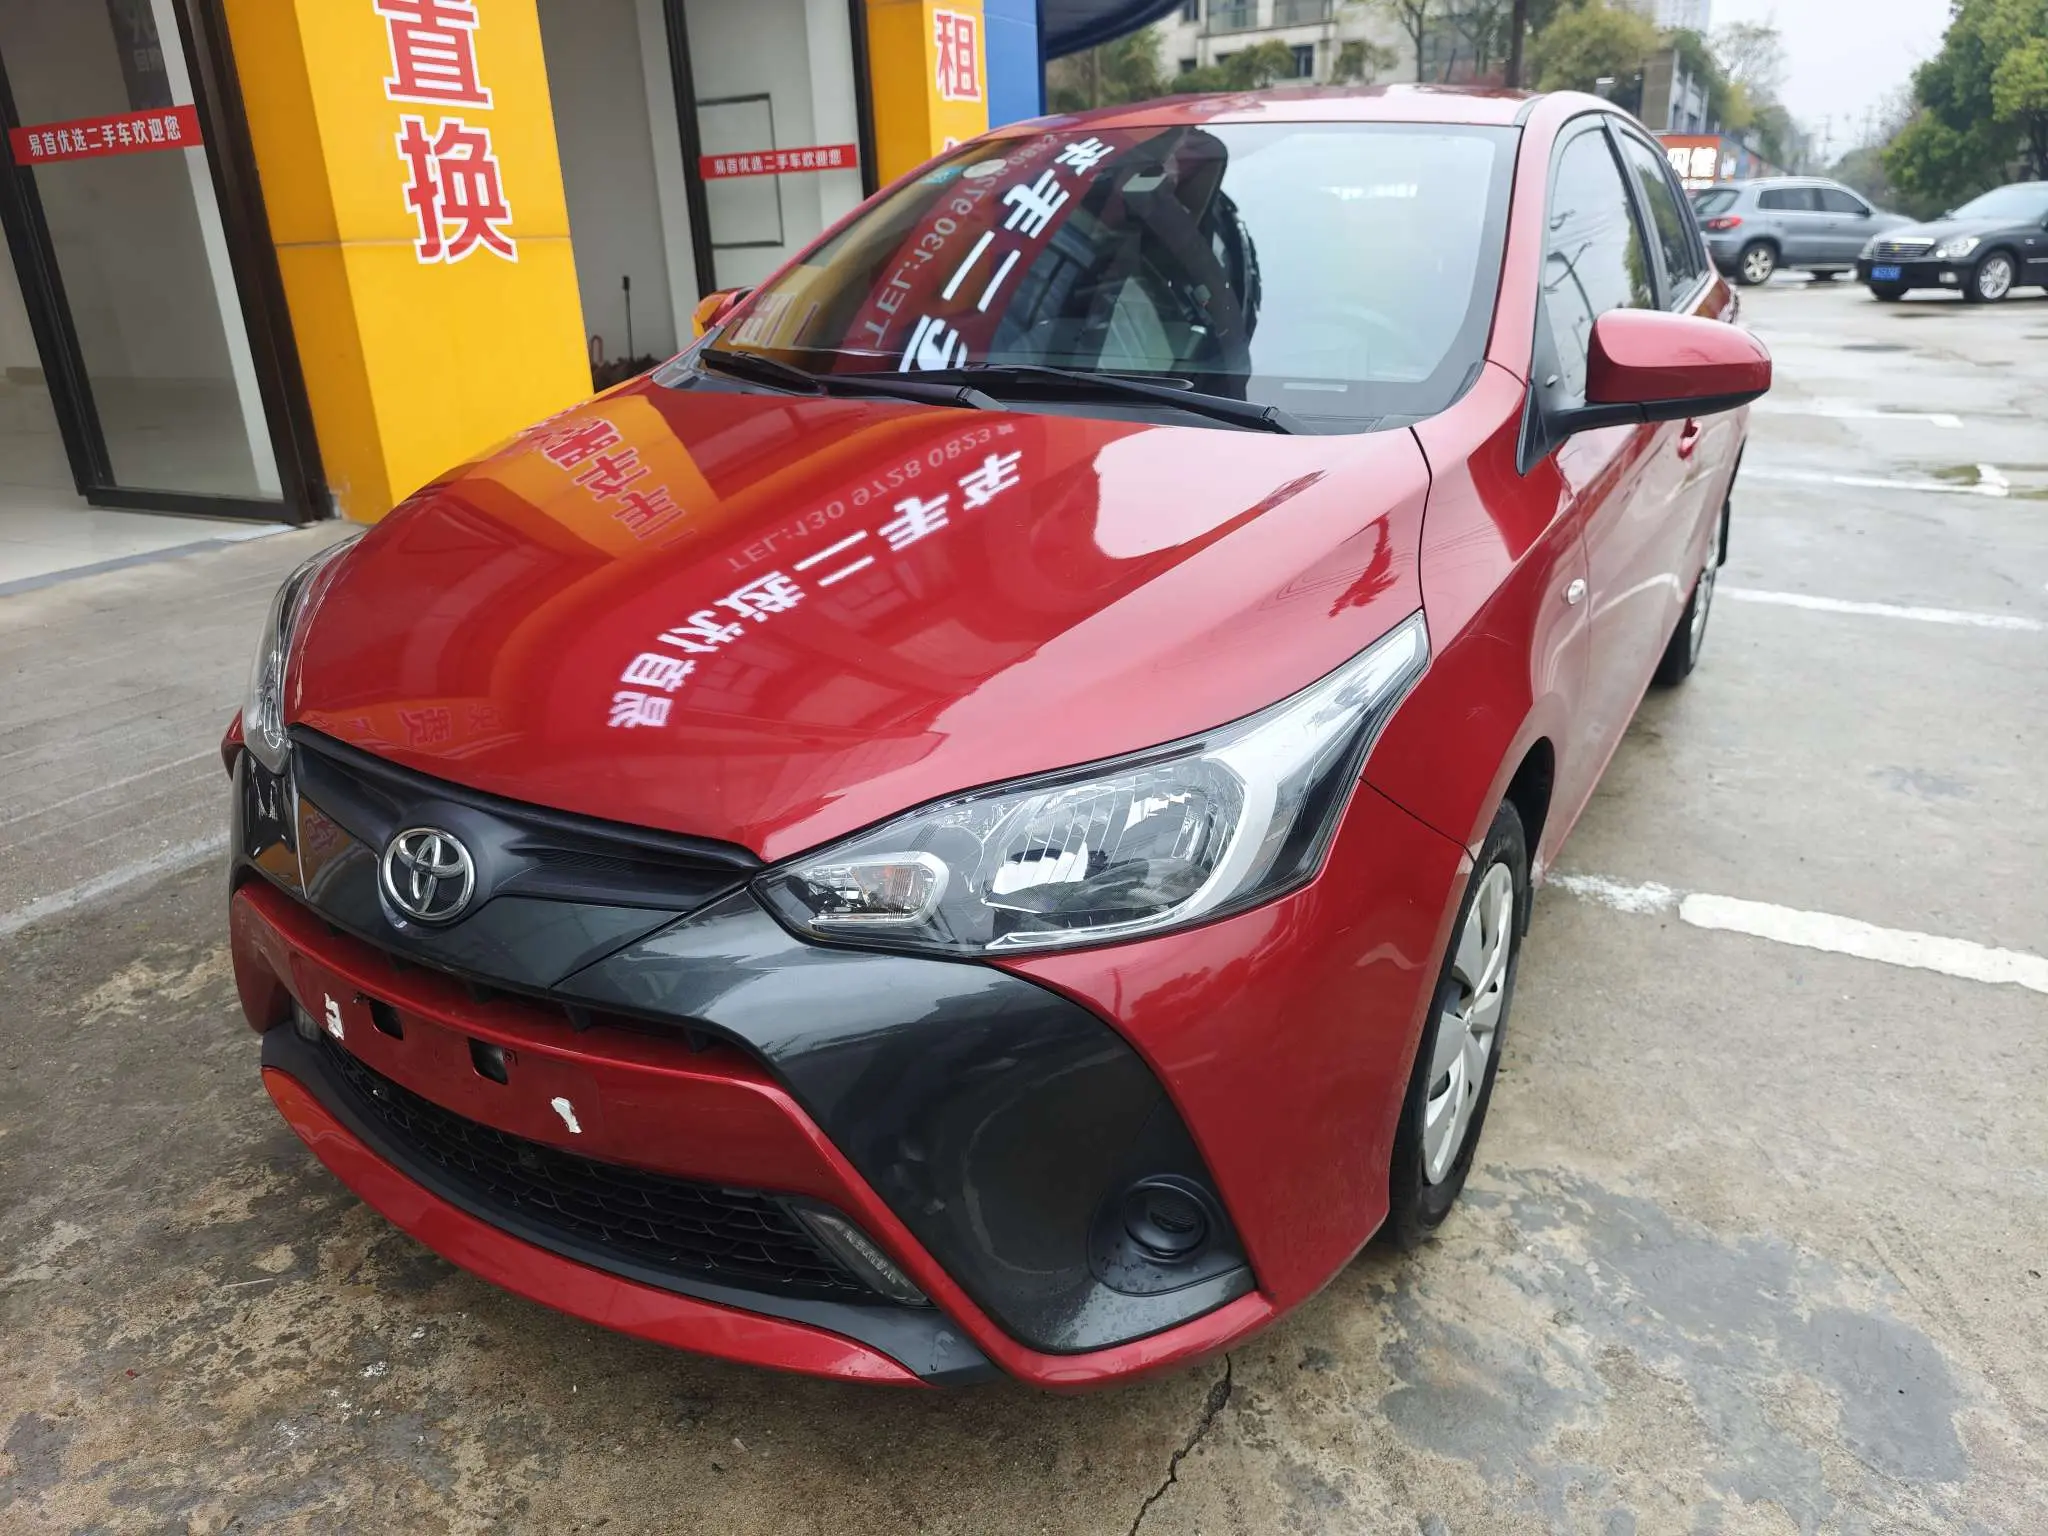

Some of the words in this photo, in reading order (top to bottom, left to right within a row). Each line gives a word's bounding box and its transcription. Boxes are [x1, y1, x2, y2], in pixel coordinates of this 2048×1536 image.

[28, 115, 182, 157] 易首优选二手车欢迎您
